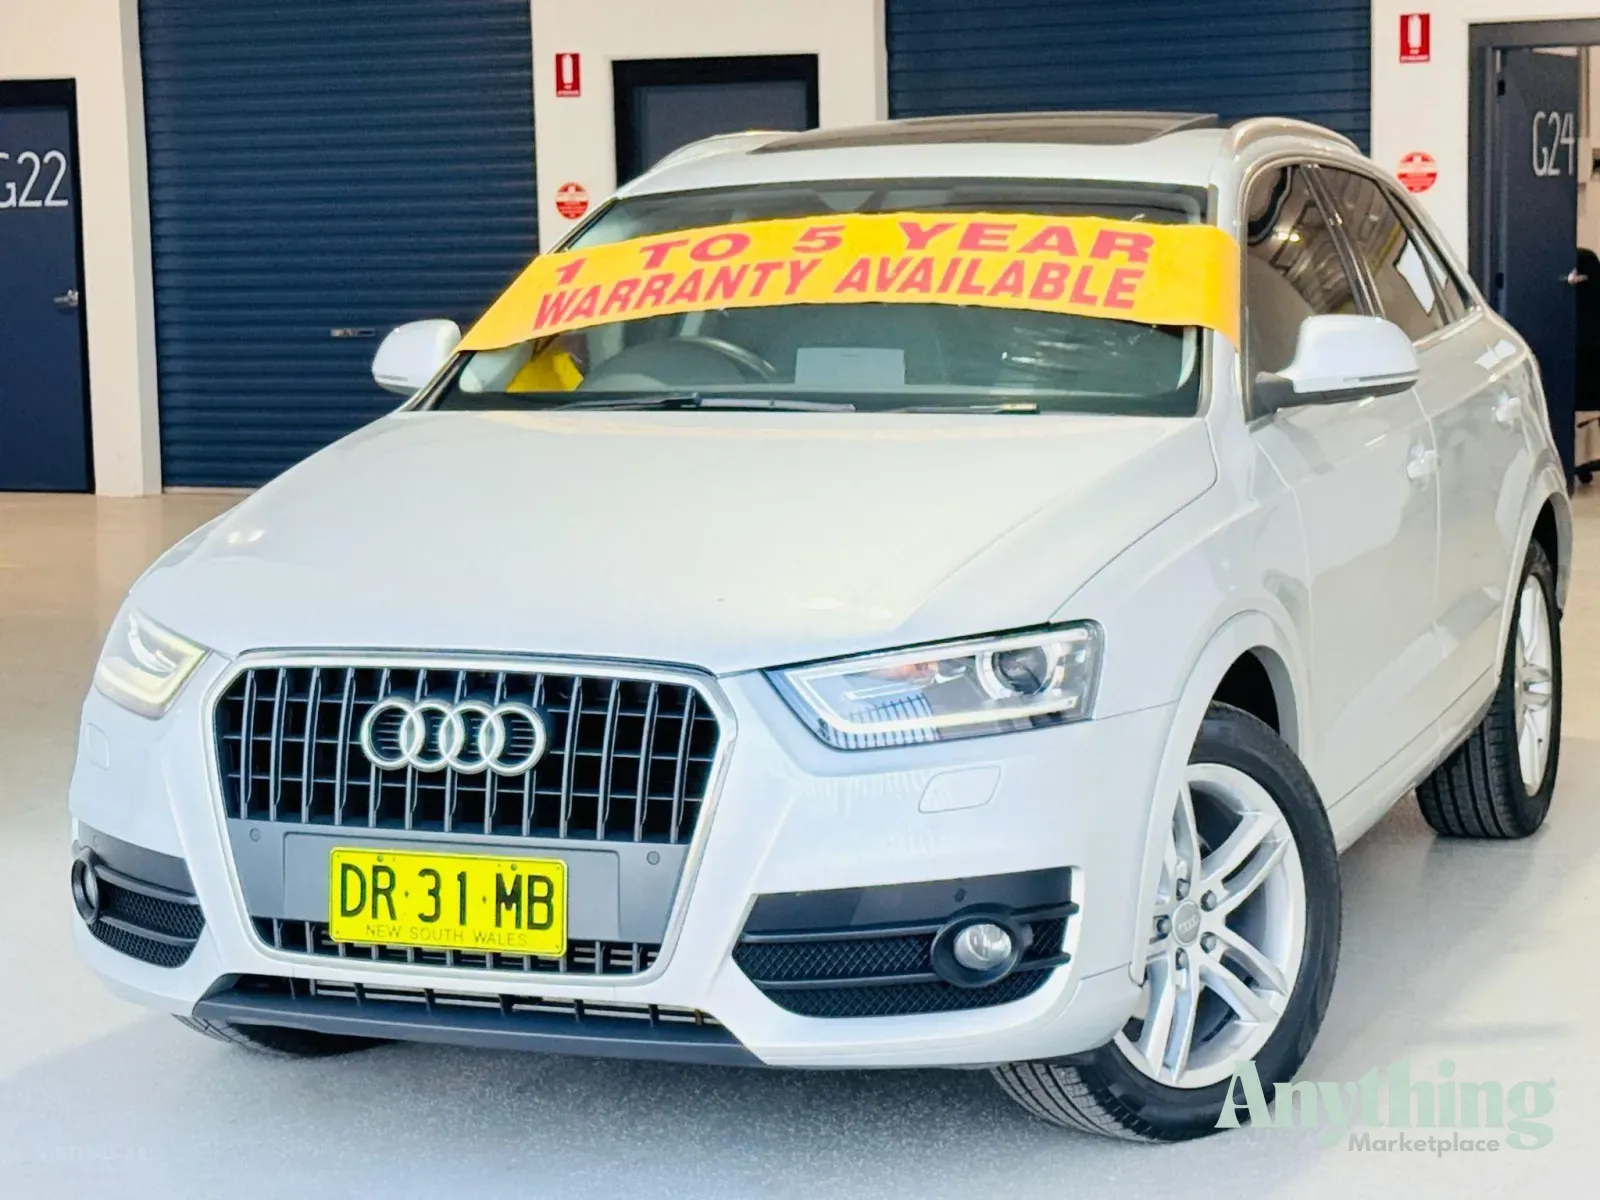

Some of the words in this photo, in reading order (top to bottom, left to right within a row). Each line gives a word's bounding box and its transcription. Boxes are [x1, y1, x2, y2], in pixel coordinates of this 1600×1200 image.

[1532, 110, 1575, 176] G24
[556, 257, 588, 285] 1
[639, 232, 750, 270] TO
[792, 225, 845, 254] 5
[899, 221, 1155, 264] YEAR
[532, 258, 822, 331] WARRANTY
[832, 256, 1145, 309] AVAILABLE
[366, 924, 401, 939] NEW
[410, 926, 463, 943] SOUTH
[474, 931, 528, 947] WALES
